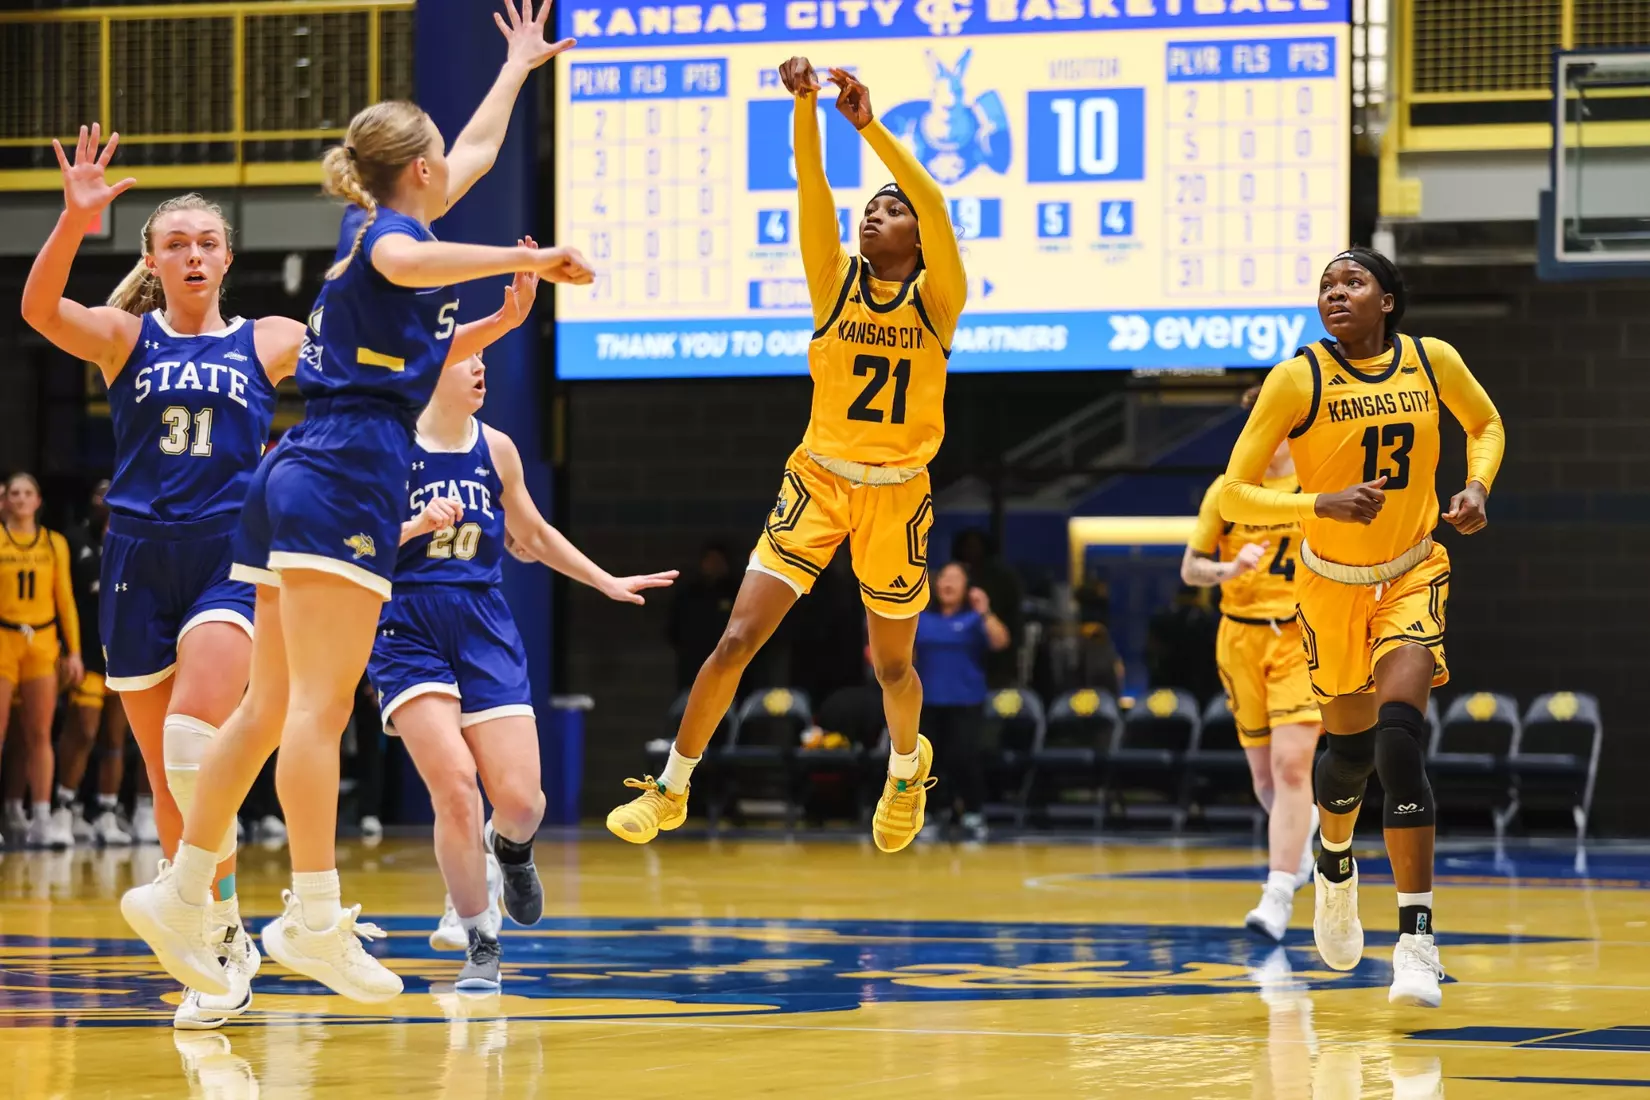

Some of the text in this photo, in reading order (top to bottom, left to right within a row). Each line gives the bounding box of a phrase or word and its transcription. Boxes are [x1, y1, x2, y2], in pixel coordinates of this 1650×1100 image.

[572, 3, 766, 37] KANSAS
[786, 0, 902, 29] CITY
[1167, 42, 1328, 75] PLYR FLS PTS
[573, 63, 721, 95] PLYR FLS PTS
[1296, 85, 1313, 115] 0
[1051, 97, 1119, 176] 10
[1240, 130, 1256, 160] 0
[1295, 129, 1312, 158] 0
[1239, 172, 1255, 203] 0
[764, 209, 786, 242] 4
[1043, 203, 1063, 236] 5
[1104, 200, 1126, 233] 4
[596, 332, 677, 360] THANK
[680, 331, 728, 358] YOU
[731, 330, 764, 357] TO
[838, 320, 896, 347] KANSAS
[1154, 314, 1306, 361] evergy
[135, 361, 248, 408] STATE
[847, 353, 911, 424] 21
[1328, 390, 1429, 422] KANSAS CITY
[159, 405, 213, 457] 31
[1361, 422, 1415, 490] 13
[410, 480, 494, 520] STATE
[426, 522, 482, 561] 20
[1269, 536, 1296, 582] 4
[18, 571, 36, 600] 11
